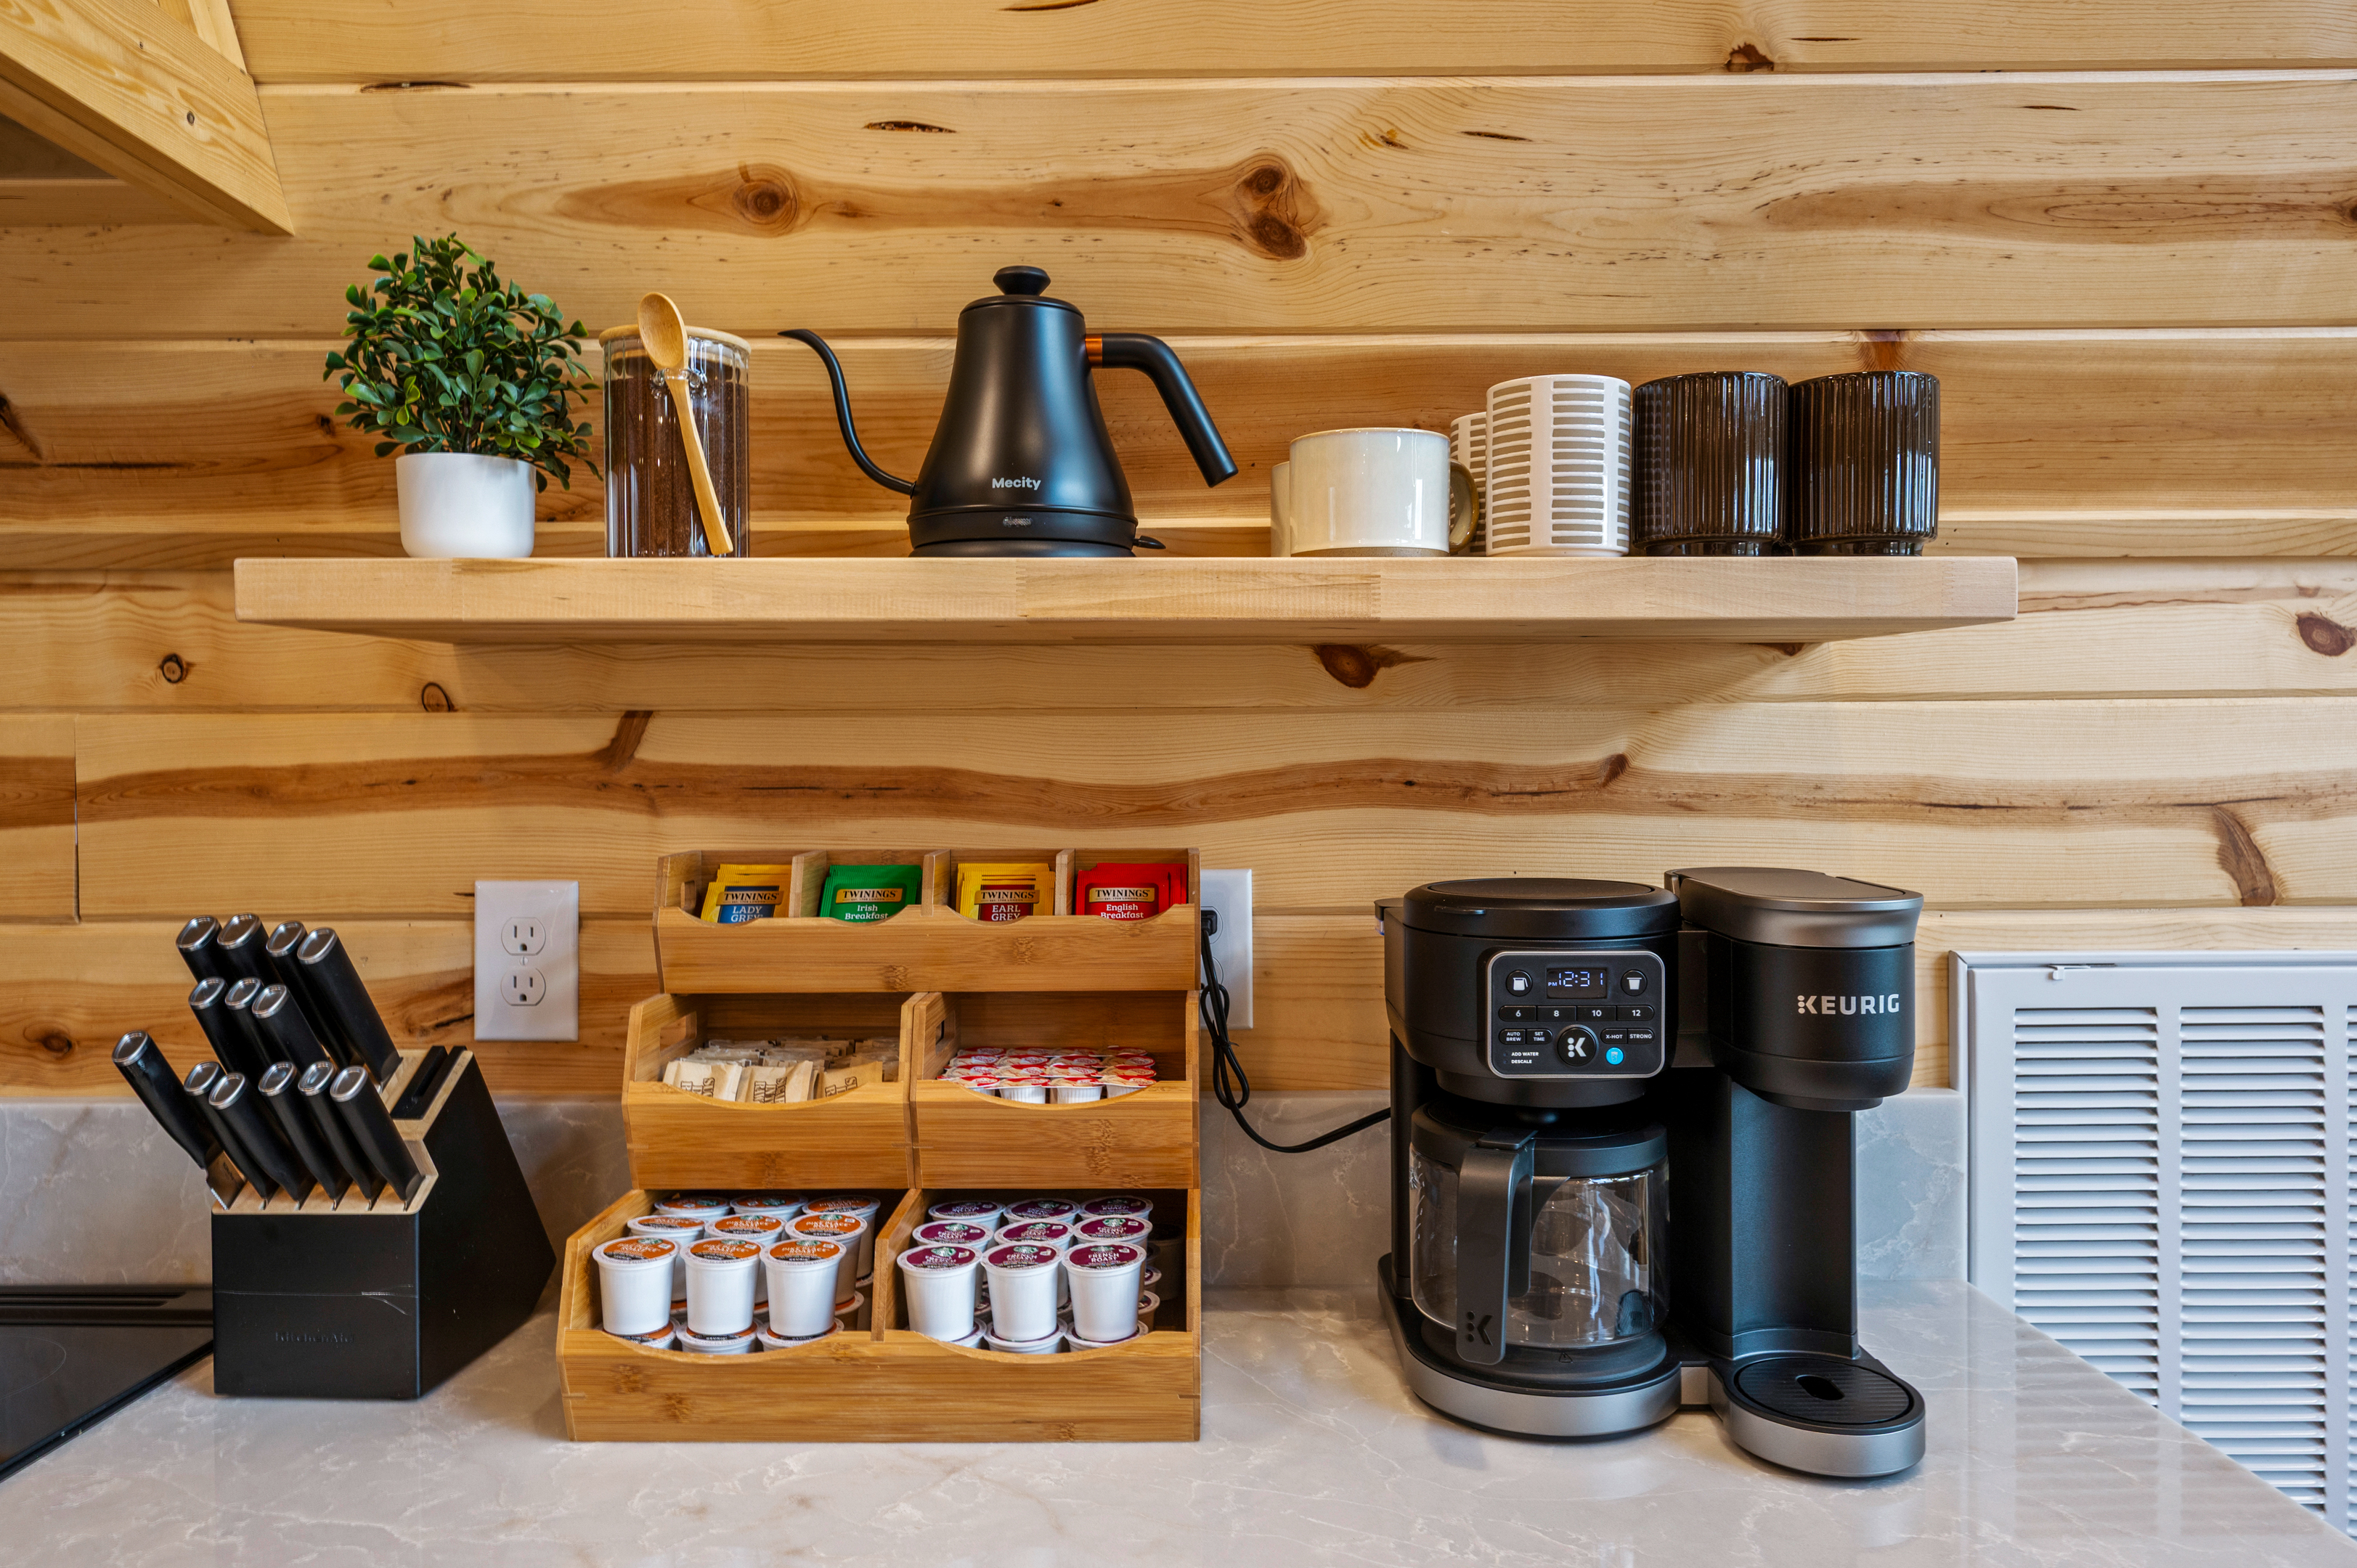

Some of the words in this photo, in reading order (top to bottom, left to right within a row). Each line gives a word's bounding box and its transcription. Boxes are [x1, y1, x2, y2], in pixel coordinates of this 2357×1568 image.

[992, 476, 1041, 490] Mecity
[843, 890, 896, 899] TWININGS
[733, 905, 762, 914] LADY
[992, 905, 1021, 913] EARL
[1106, 903, 1139, 912] English
[844, 912, 889, 920] Breakfast
[991, 912, 1020, 921] GREY
[1797, 994, 1900, 1015] KEURIG
